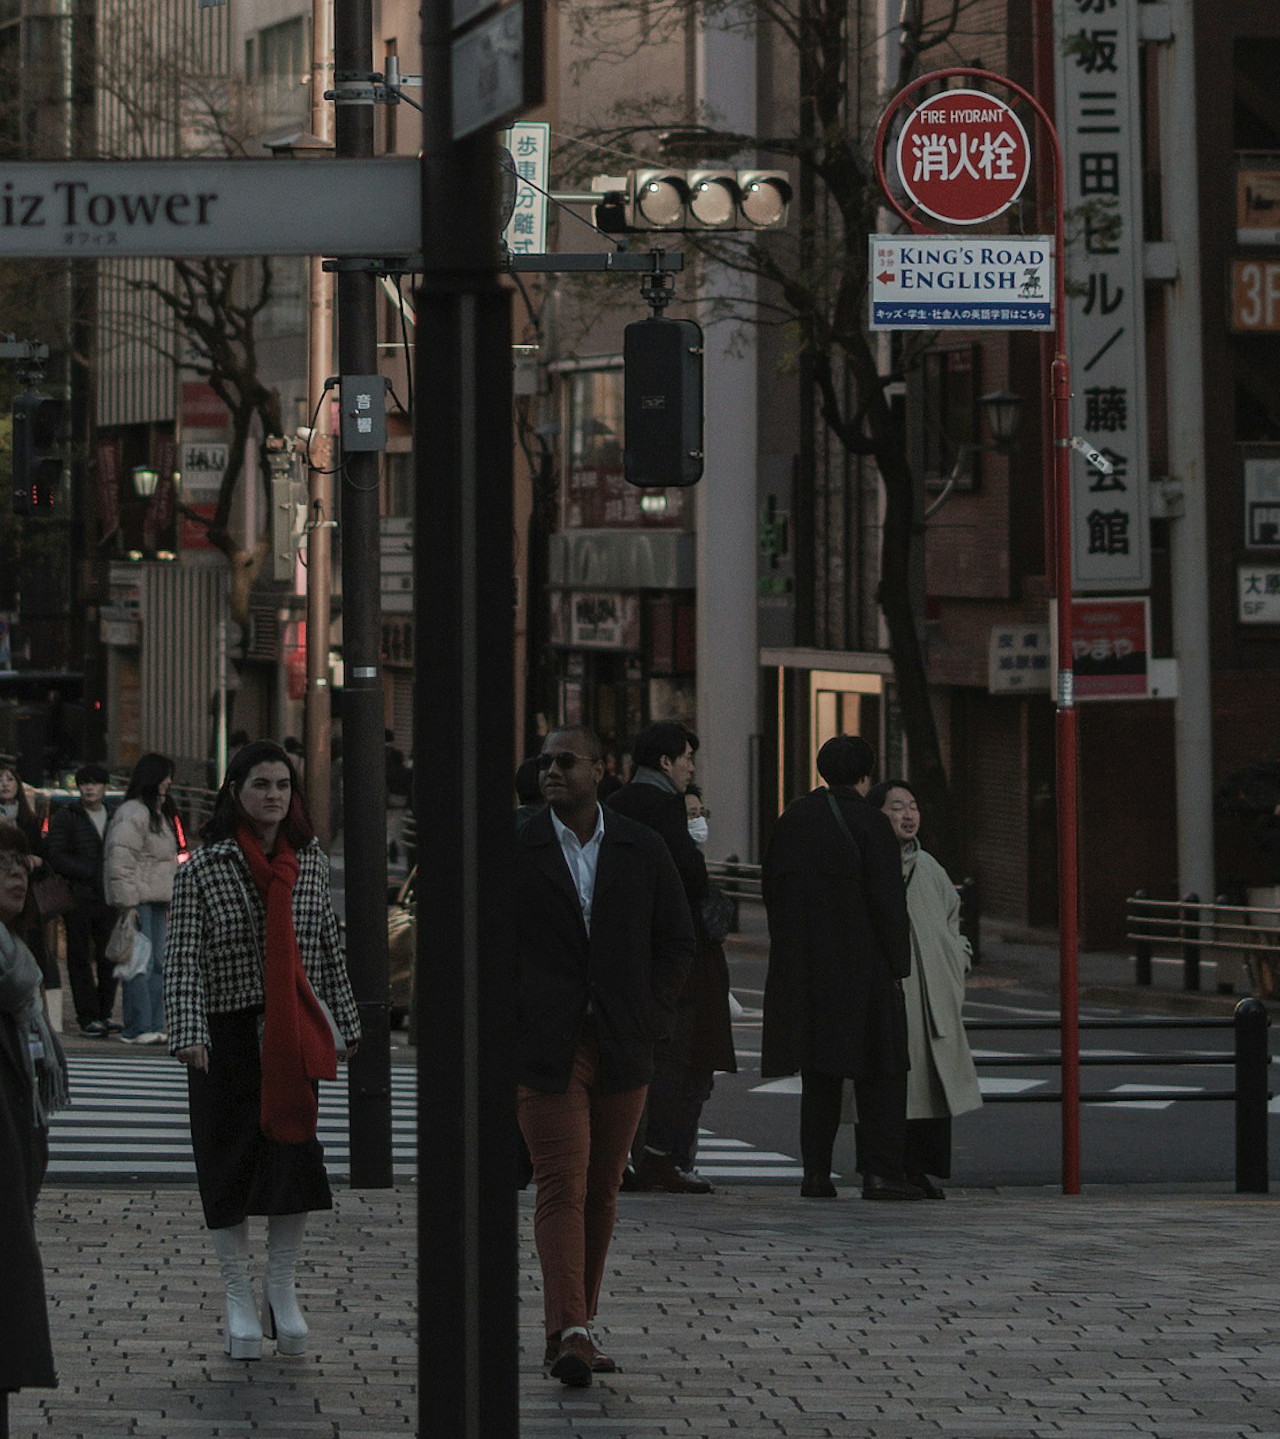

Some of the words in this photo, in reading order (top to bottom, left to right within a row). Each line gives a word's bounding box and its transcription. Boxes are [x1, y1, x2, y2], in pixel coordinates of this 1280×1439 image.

[920, 109, 946, 124] FIRE
[950, 108, 1004, 123] HYDRANT
[911, 130, 1017, 181] 消火栓
[53, 180, 219, 225] Tower
[900, 247, 973, 265] KING'S
[980, 249, 1045, 265] ROAD
[900, 270, 1016, 289] ENGLISH
